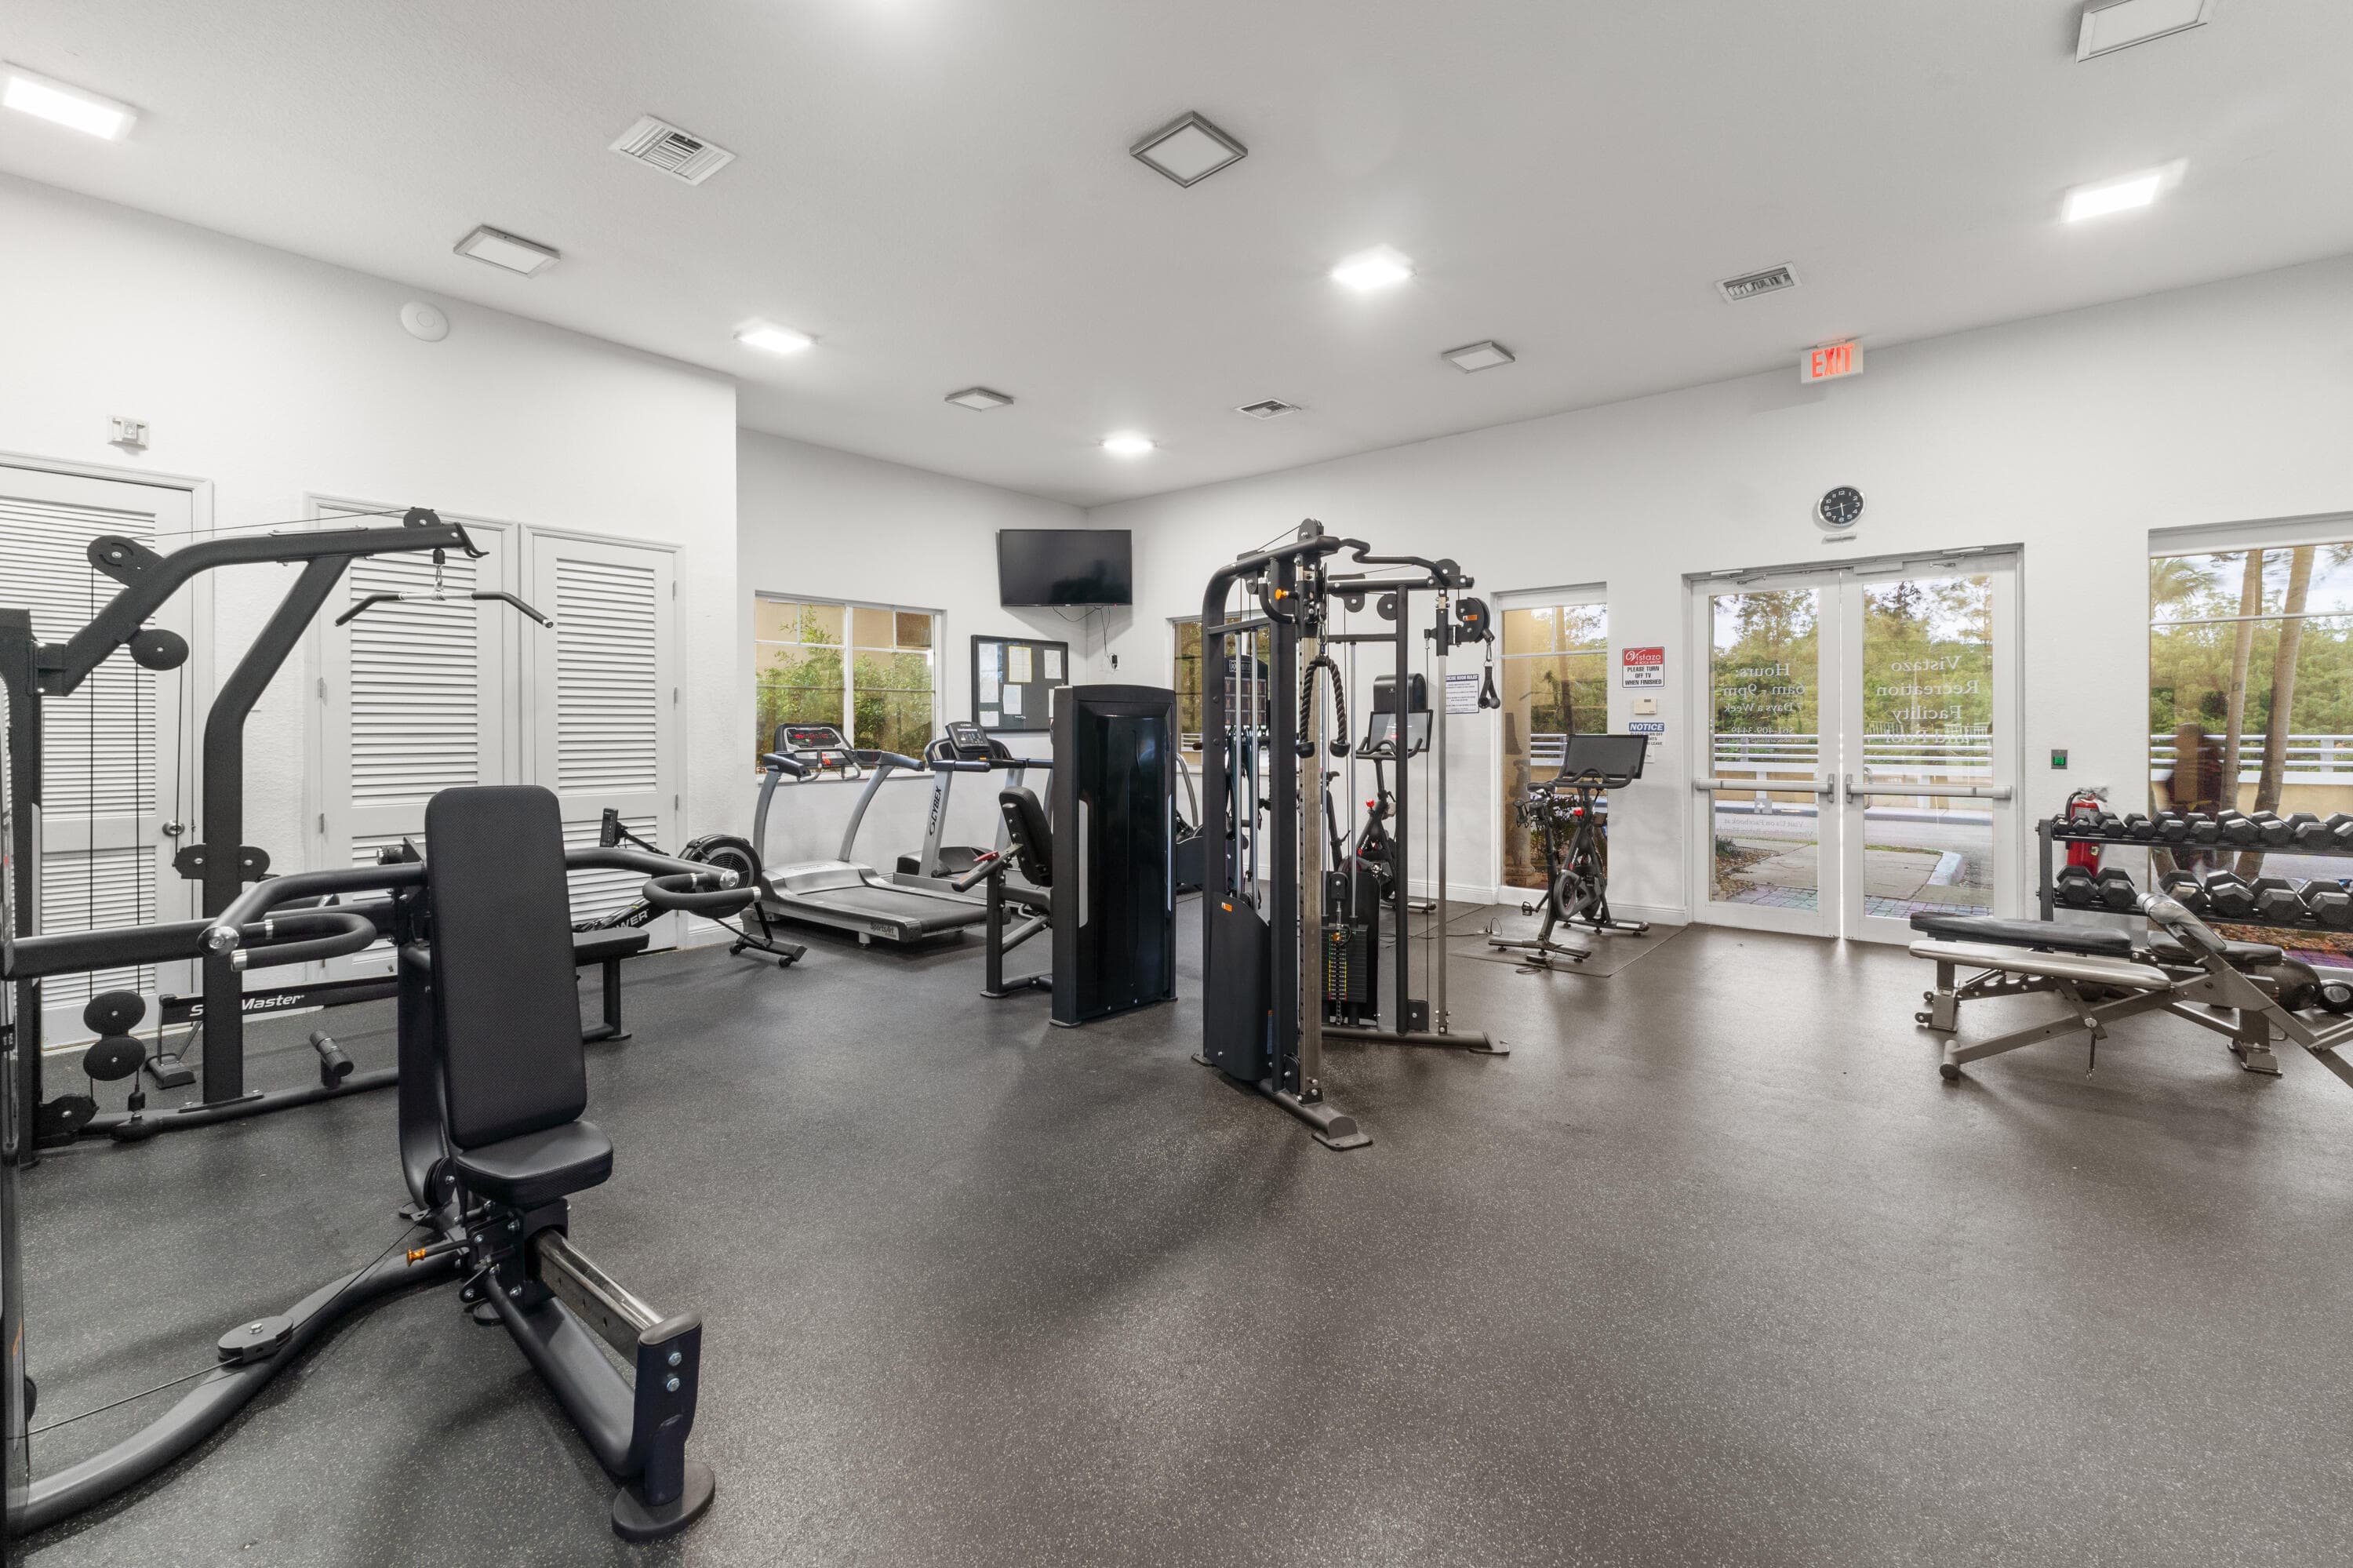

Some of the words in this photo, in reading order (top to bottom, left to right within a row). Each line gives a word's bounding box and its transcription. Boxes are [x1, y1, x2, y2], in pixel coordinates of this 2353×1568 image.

[1812, 344, 1855, 377] EXIT
[1625, 649, 1661, 661] Vistazo
[931, 785, 942, 822] CYBEX
